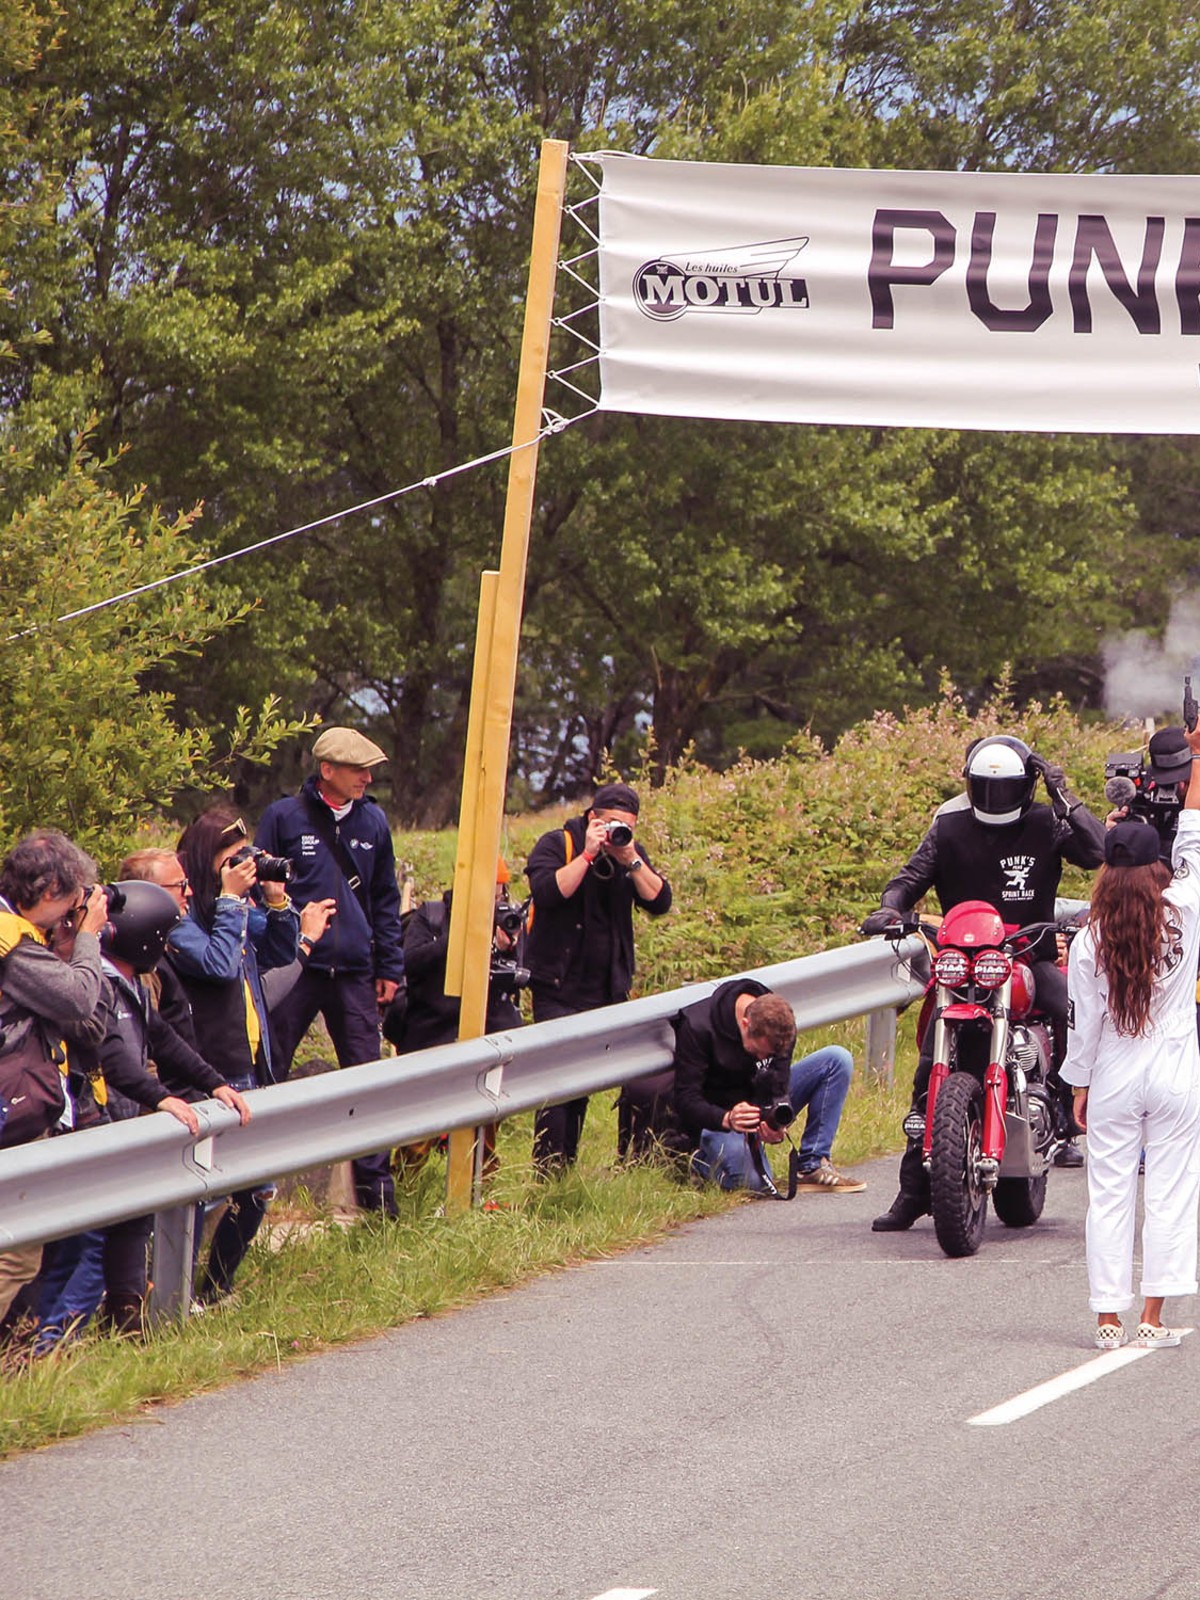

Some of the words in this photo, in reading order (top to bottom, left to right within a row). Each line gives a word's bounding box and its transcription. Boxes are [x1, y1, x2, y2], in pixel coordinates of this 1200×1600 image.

[685, 262, 702, 273] Les
[704, 263, 739, 274] huiles
[643, 273, 808, 308] MOTUL
[1000, 855, 1036, 869] PUNK'S
[935, 964, 964, 972] PIAA
